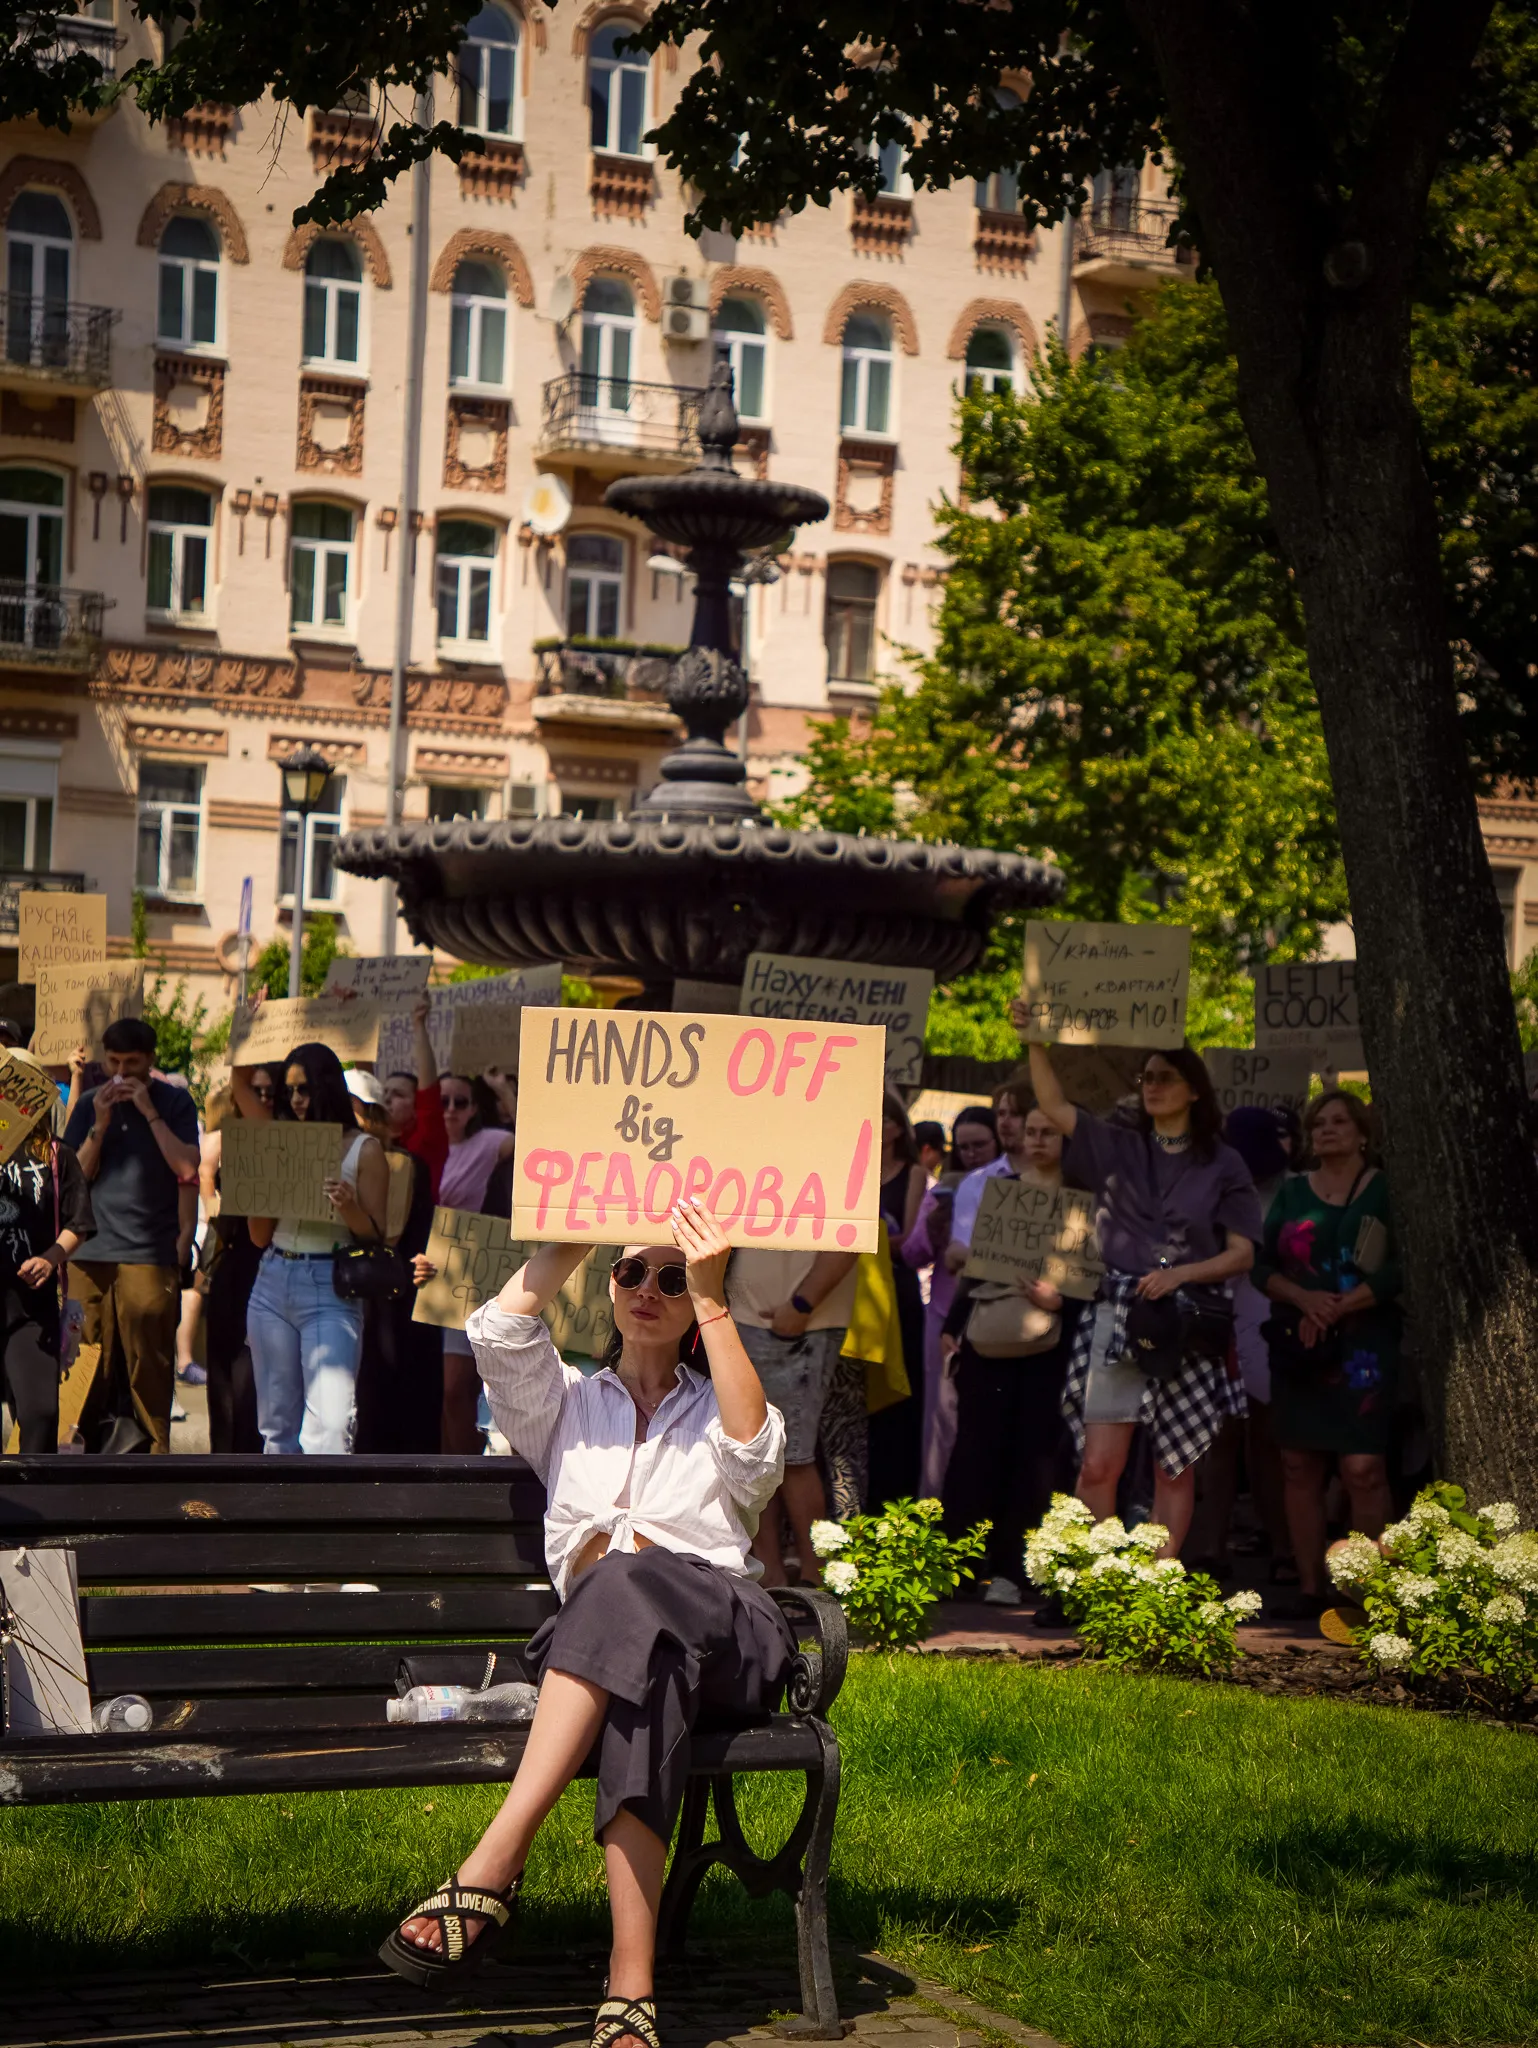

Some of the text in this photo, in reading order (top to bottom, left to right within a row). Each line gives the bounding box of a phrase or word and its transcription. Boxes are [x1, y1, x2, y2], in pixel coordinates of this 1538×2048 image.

[24, 906, 78, 925] РУСНЯ
[51, 926, 95, 945] РАДІЄ
[1264, 965, 1322, 997] LET
[1263, 995, 1351, 1029] COOK
[546, 1017, 706, 1089] HANDS
[726, 1027, 858, 1102] OFF
[523, 1147, 873, 1247] ФЕДОРОВА!
[441, 1212, 480, 1245] ЦЕ
[455, 1892, 482, 1912] LOVE
[624, 2007, 653, 2034] LOVE
